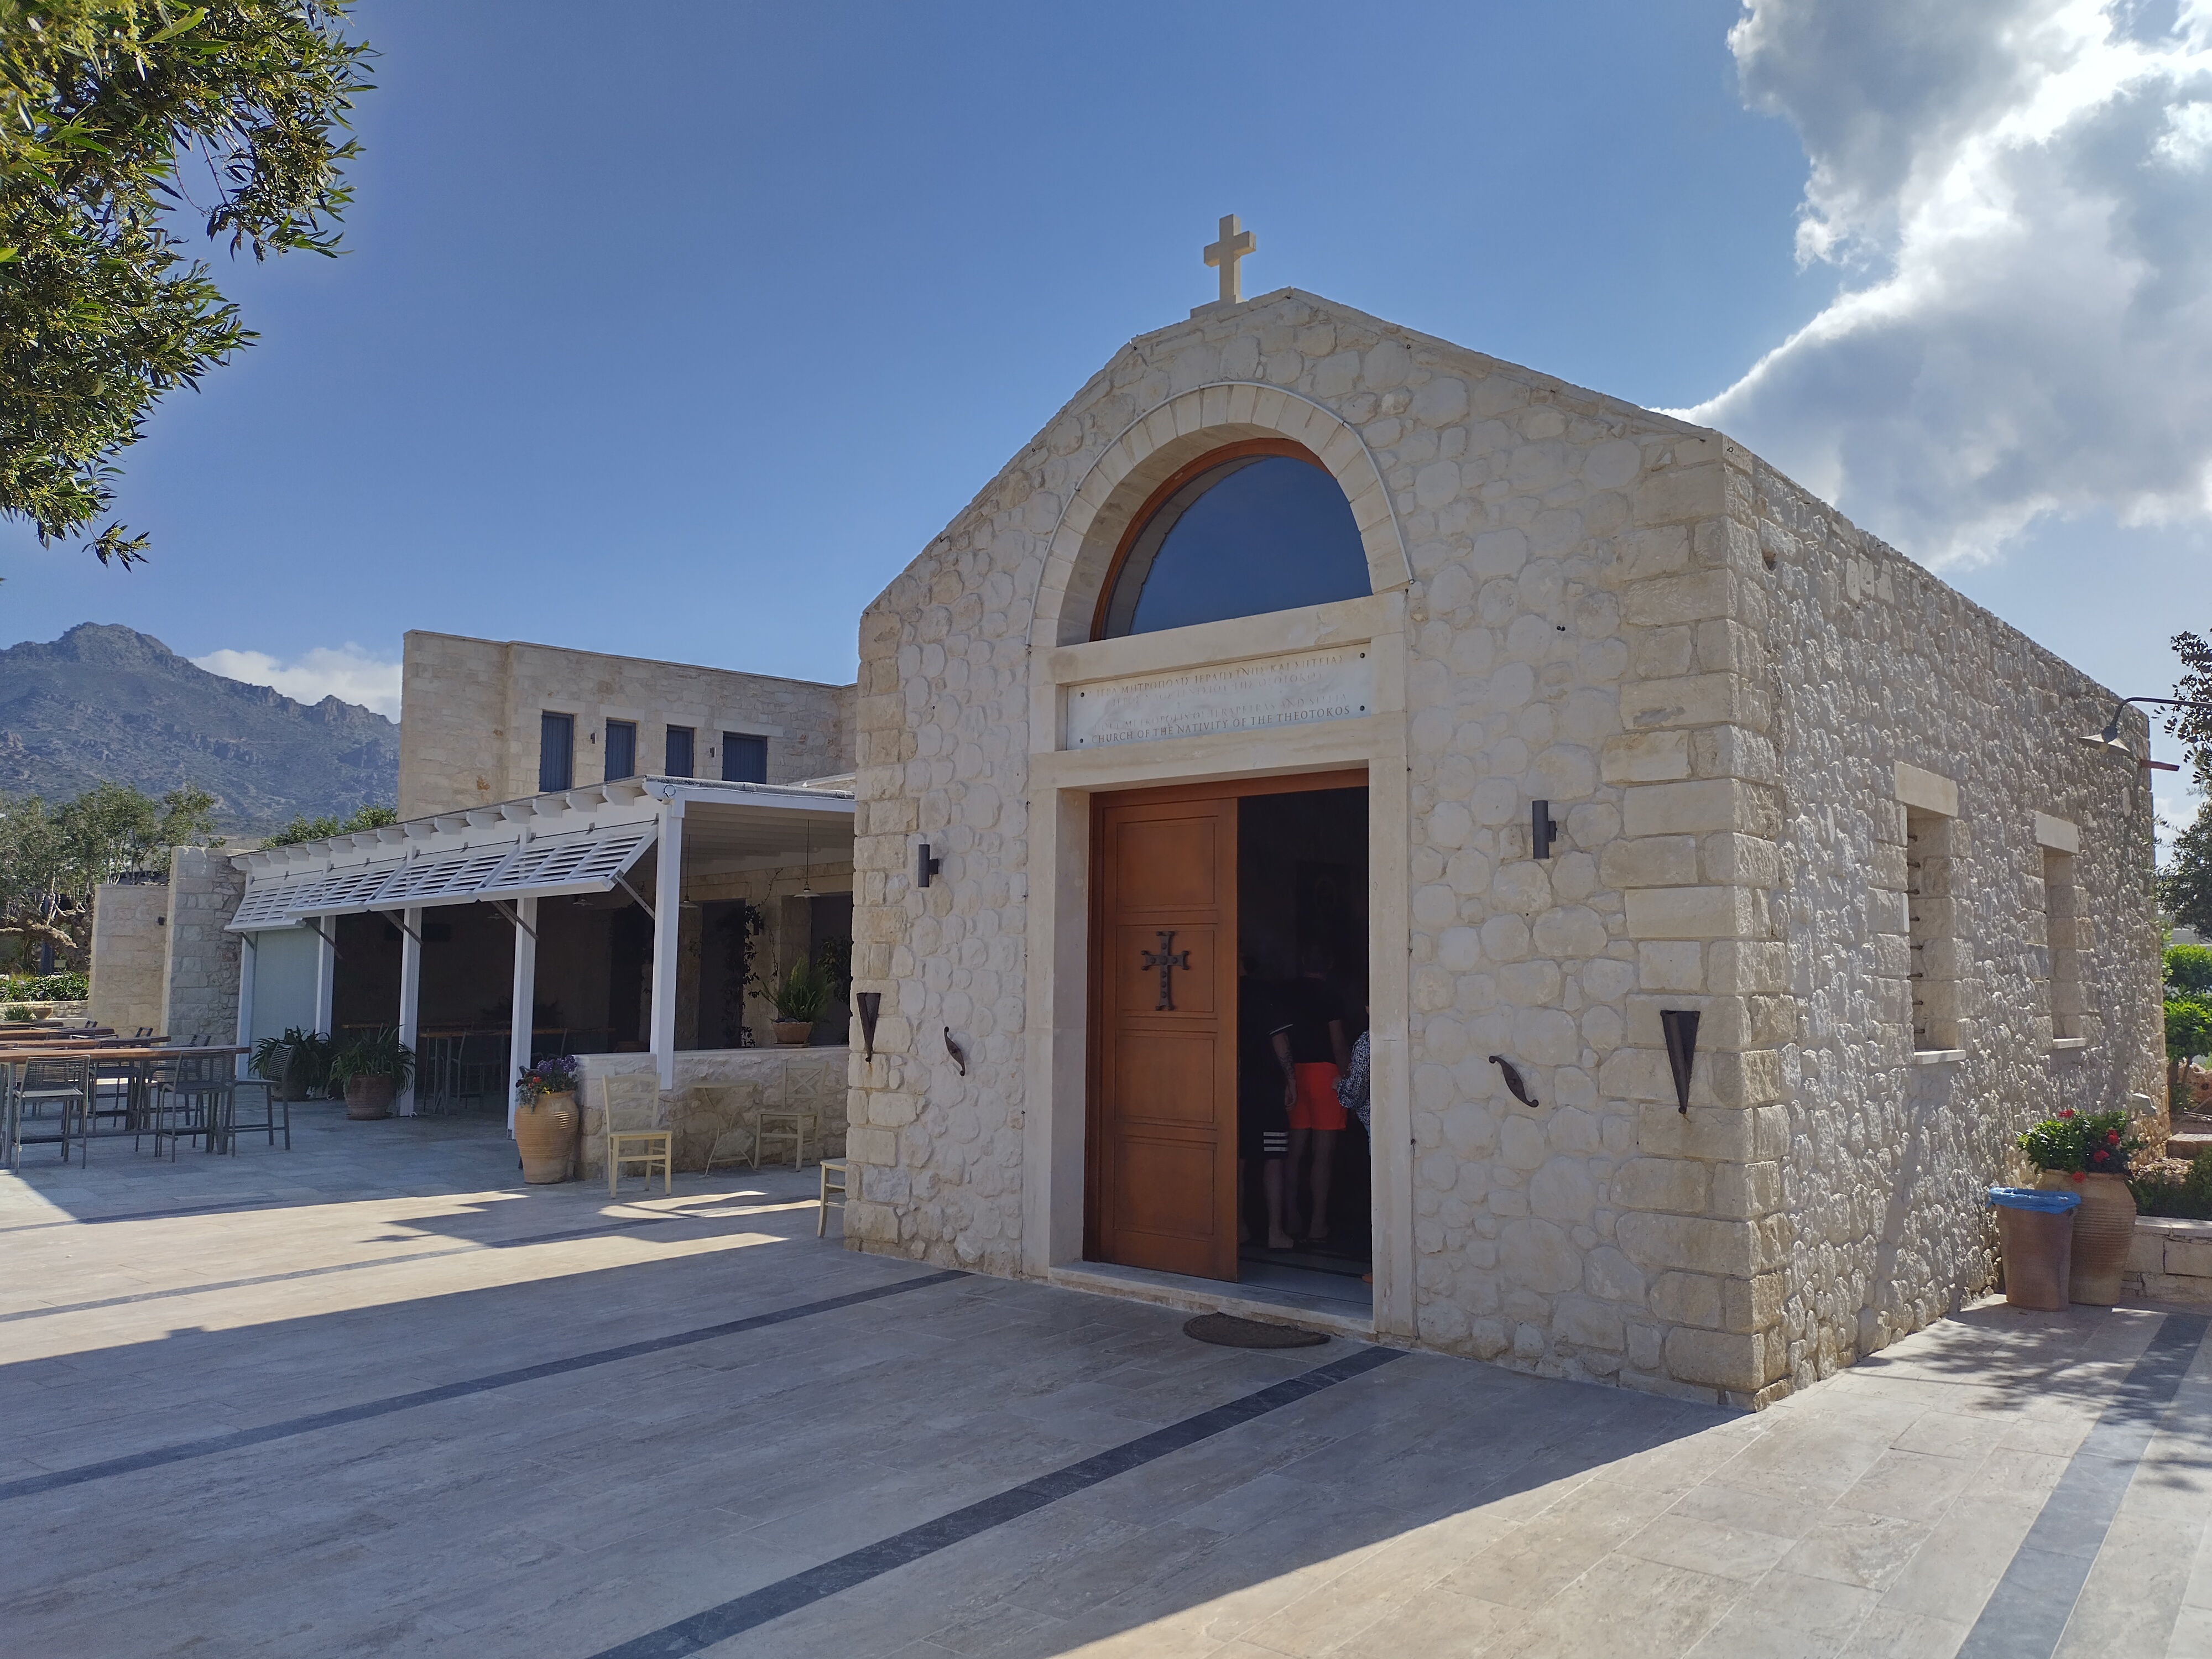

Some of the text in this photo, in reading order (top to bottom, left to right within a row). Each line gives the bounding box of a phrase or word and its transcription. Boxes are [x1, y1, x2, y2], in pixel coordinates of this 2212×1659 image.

[1271, 663, 1289, 672] ΚΑΙ
[1092, 705, 1349, 744] CHURCH OF THE NATIVITY OF THE THEOTOKOS
